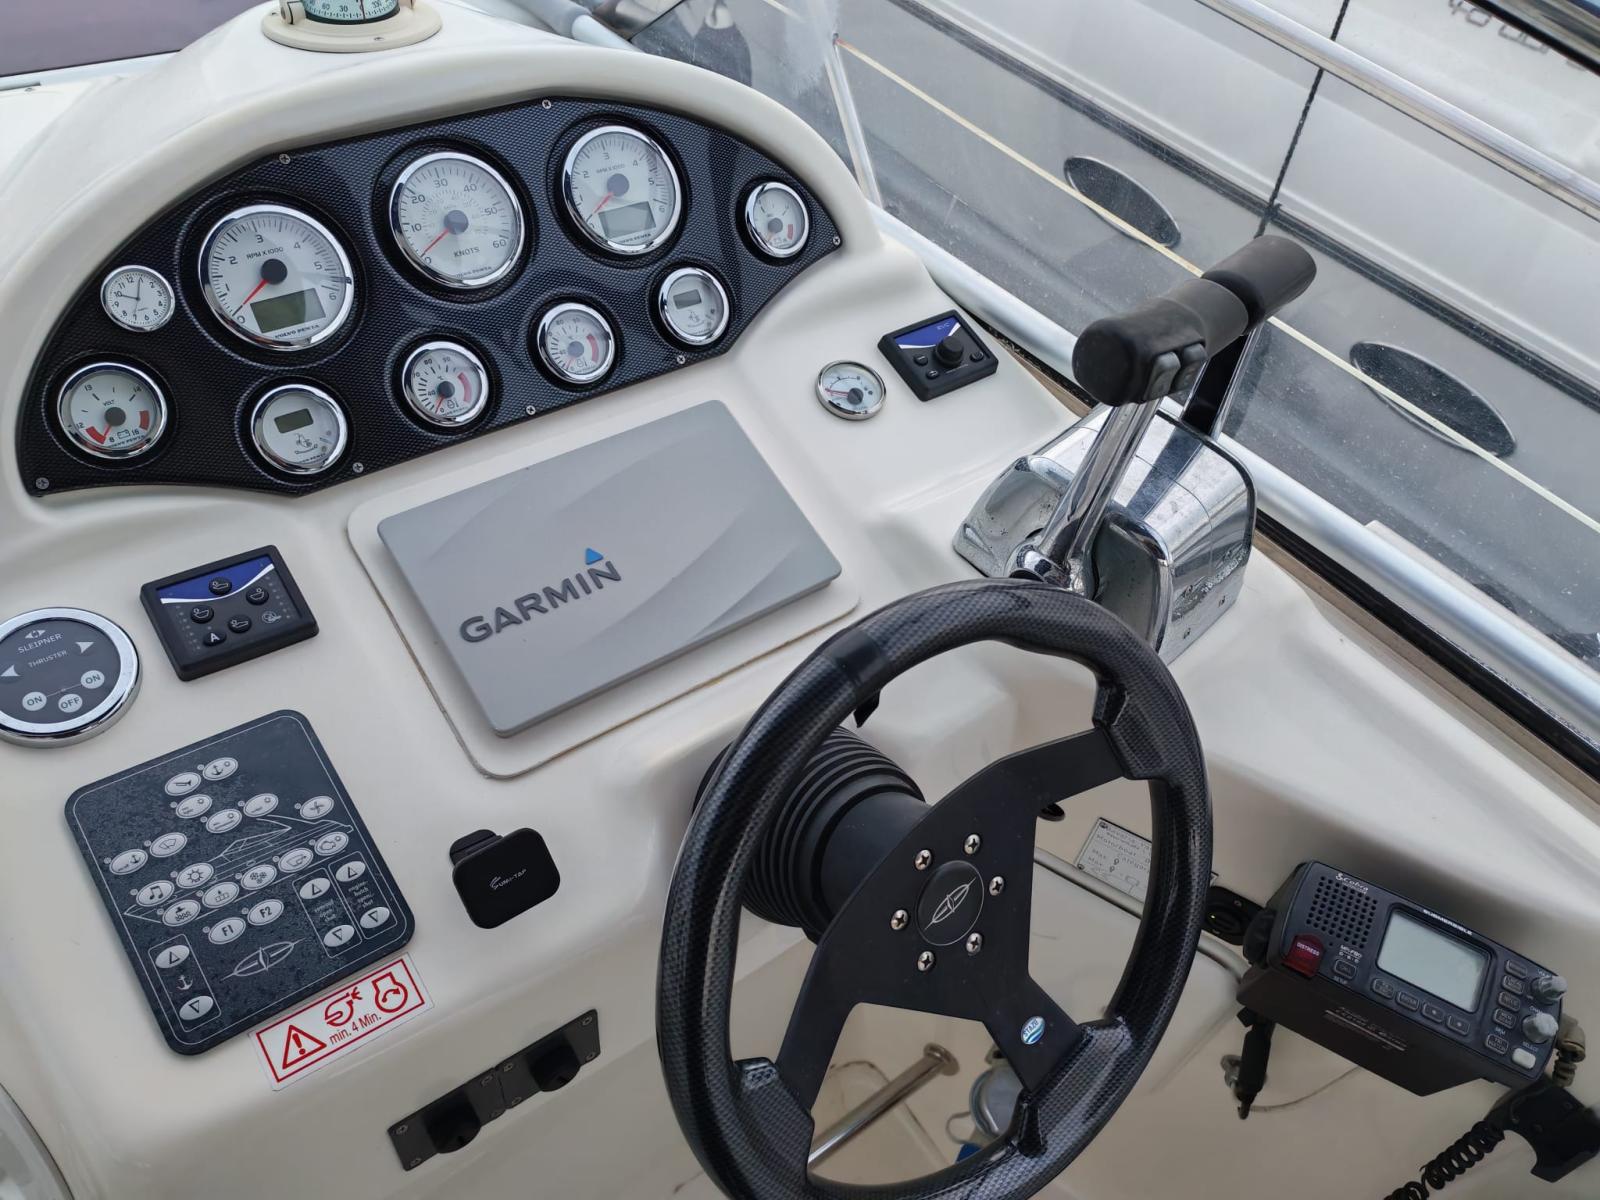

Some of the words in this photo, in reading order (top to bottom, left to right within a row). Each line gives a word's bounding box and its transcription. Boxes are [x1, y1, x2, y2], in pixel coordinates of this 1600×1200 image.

[434, 178, 448, 188] 30
[464, 184, 477, 192] 40
[412, 194, 426, 204] 20
[484, 206, 498, 216] 50
[411, 223, 422, 232] 10
[256, 234, 264, 244] 3
[492, 240, 506, 248] 60
[294, 241, 300, 249] 4
[246, 252, 262, 260] RPM
[454, 246, 480, 258] KNOTS
[228, 256, 238, 265] 2
[314, 262, 322, 270] 5
[328, 292, 336, 300] 6
[84, 384, 92, 392] 13
[102, 399, 115, 407] VOLT
[460, 560, 622, 642] GARMIN
[210, 632, 220, 643] A
[18, 633, 63, 654] SLEIPNER
[28, 650, 68, 668] THRUSTER
[85, 674, 101, 684] ON
[26, 696, 42, 706] ON
[60, 697, 81, 708] OFF
[260, 906, 272, 918] F2
[1422, 908, 1472, 936] SUBMERSIBLE
[222, 924, 234, 936] F1
[1296, 942, 1320, 956] DISTRESS
[329, 1028, 352, 1045] min.
[352, 1022, 359, 1032] 4
[359, 1013, 382, 1029] Min.
